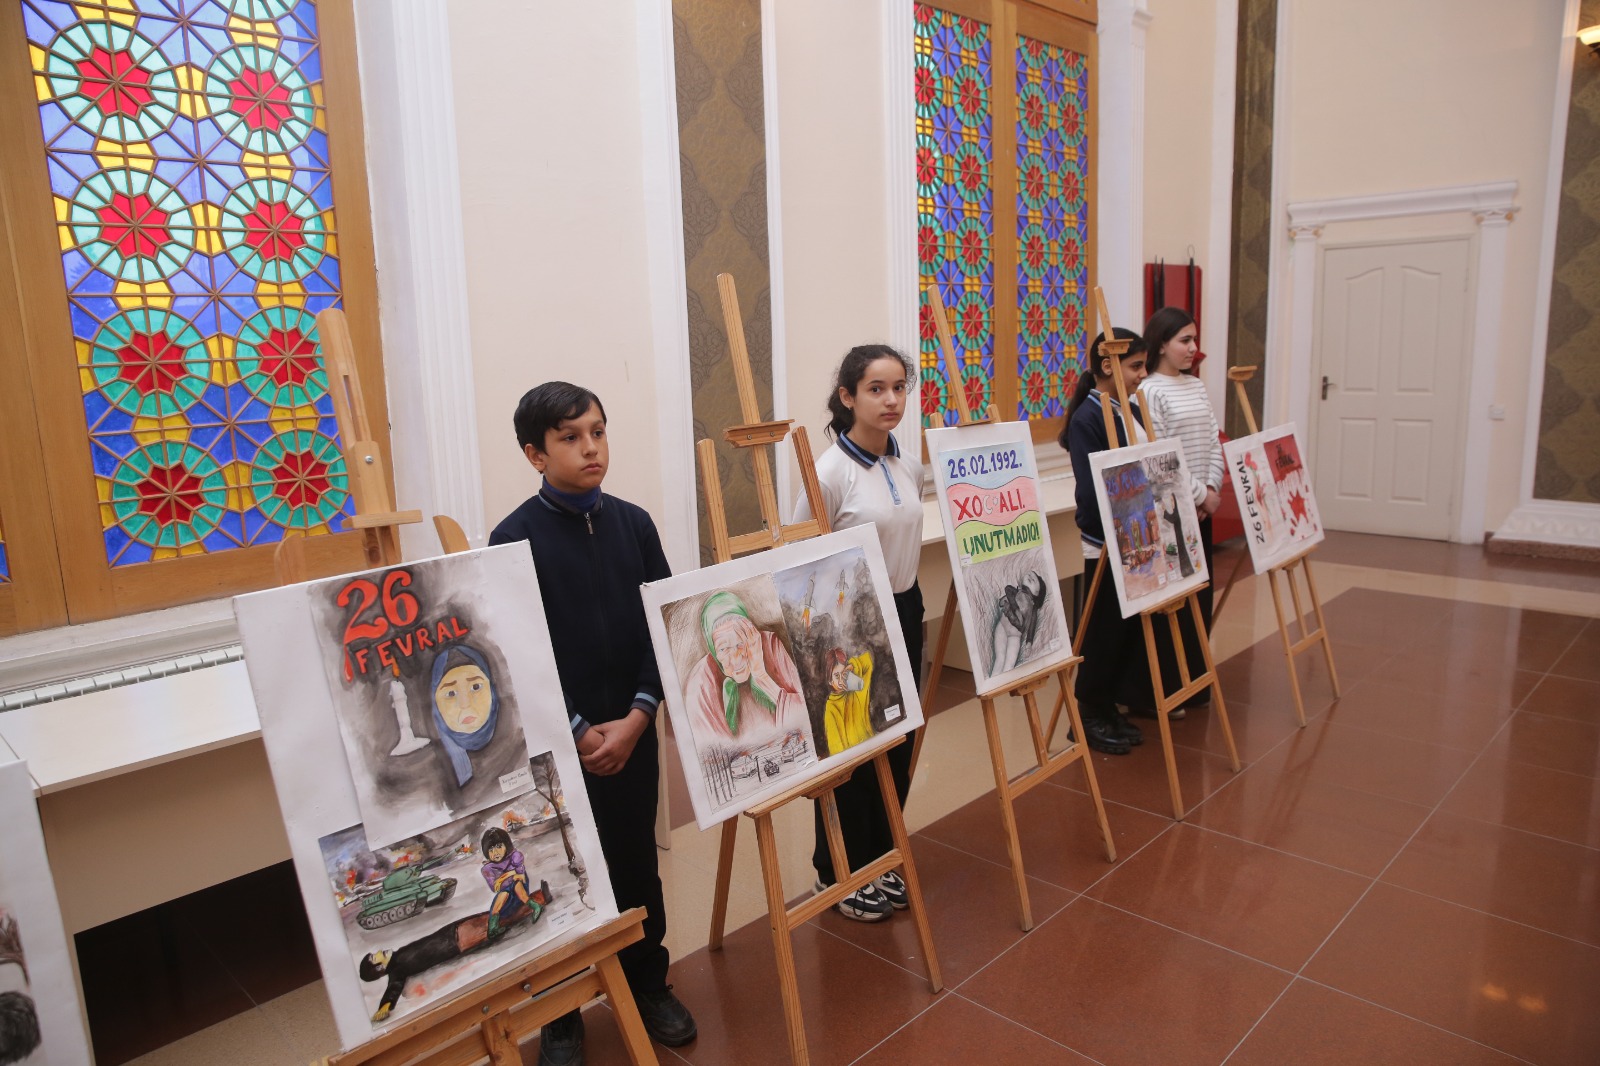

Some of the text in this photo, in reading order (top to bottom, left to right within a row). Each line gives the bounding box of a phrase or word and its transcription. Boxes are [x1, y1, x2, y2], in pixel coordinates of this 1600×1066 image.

[947, 450, 1023, 479] 26.02.1992.
[336, 570, 419, 646] 26
[355, 617, 469, 674] FEVRAL
